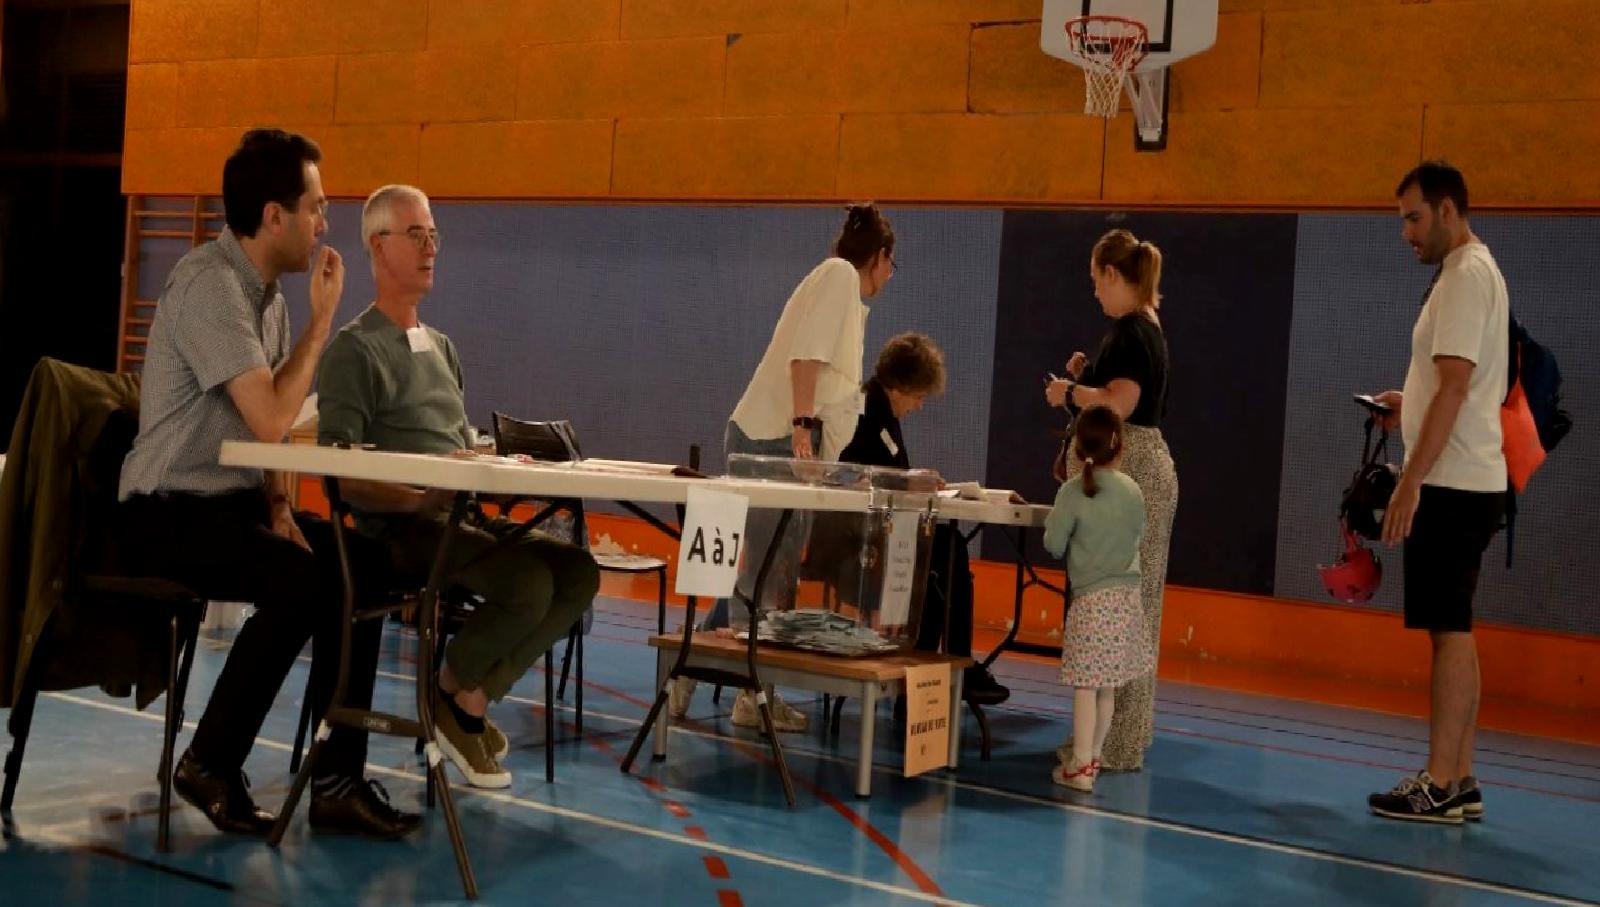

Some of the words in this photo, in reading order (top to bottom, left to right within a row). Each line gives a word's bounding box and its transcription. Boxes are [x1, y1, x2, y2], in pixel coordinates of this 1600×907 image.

[687, 526, 706, 563] A
[713, 528, 724, 565] à
[729, 533, 739, 567] J
